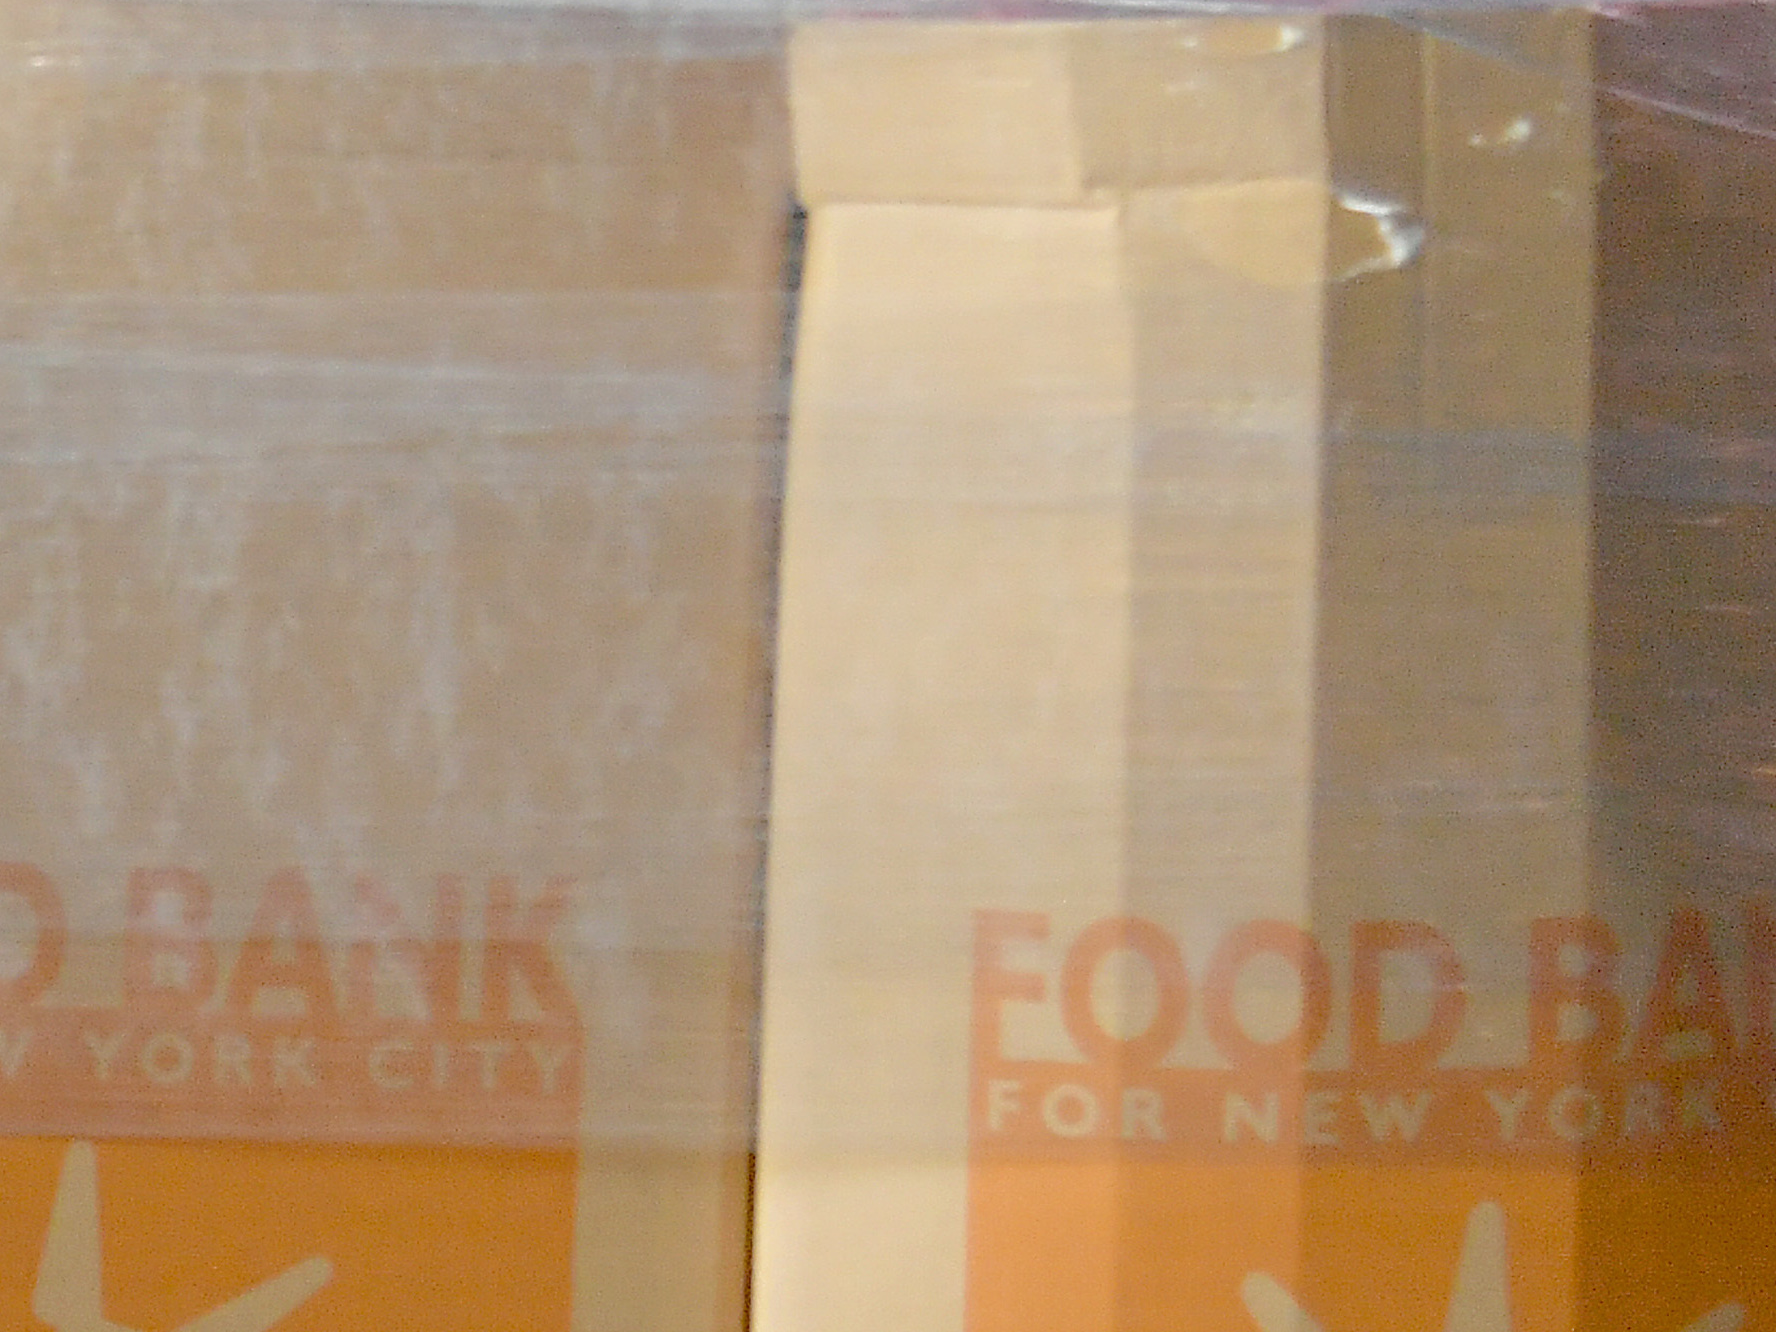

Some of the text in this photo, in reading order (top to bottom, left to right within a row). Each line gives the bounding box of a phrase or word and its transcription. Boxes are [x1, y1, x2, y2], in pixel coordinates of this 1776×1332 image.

[124, 866, 578, 1026] BANK
[971, 896, 1776, 1070] FOOD BA
[82, 1027, 318, 1090] YORK
[367, 1036, 574, 1093] CITY
[987, 1079, 1724, 1146] FOR NEW YORK
